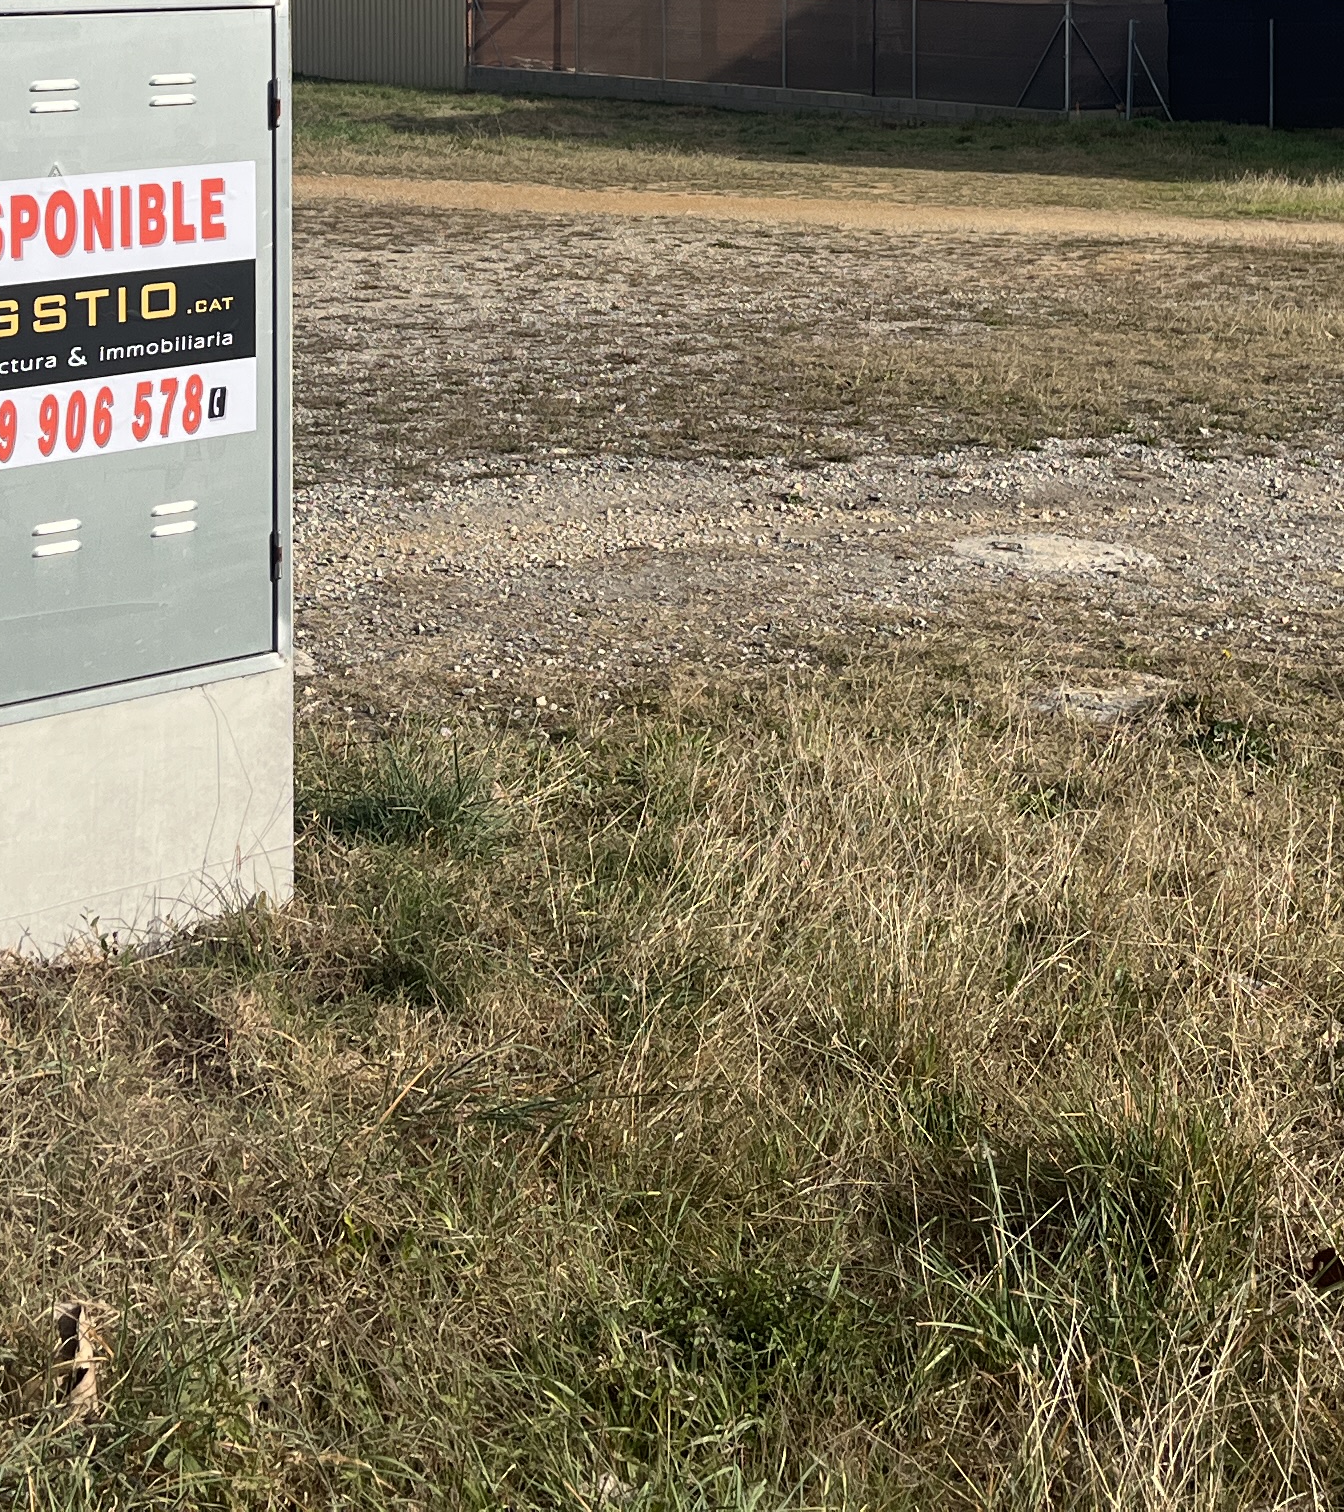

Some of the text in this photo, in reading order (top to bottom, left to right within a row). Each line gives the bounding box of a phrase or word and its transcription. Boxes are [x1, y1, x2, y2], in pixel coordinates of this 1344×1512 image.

[67, 346, 88, 367] &
[99, 331, 233, 362] immobiliaria
[37, 386, 114, 456] 906
[131, 374, 204, 441] 578
